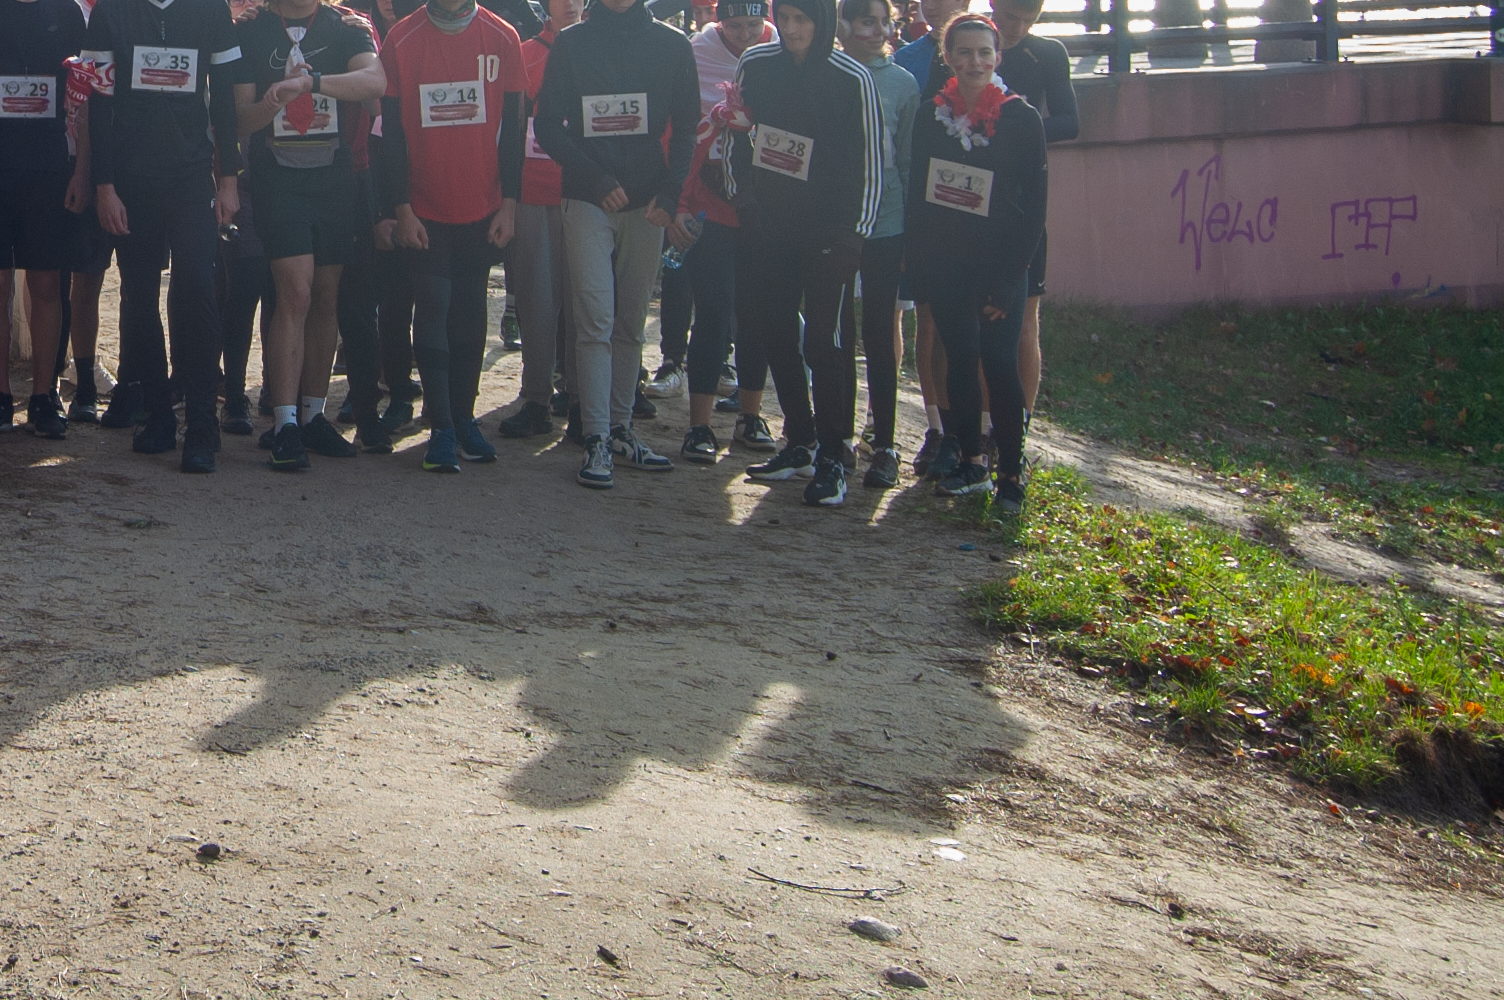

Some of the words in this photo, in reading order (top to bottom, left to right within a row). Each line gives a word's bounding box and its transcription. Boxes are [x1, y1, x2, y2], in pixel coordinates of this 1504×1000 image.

[725, 2, 762, 17] OREVER
[169, 56, 190, 70] 35
[477, 55, 500, 83] 10
[29, 83, 48, 97] 29
[457, 88, 477, 103] 14
[313, 98, 329, 112] 24
[620, 100, 639, 115] 15
[786, 140, 806, 157] 28
[964, 175, 972, 191] 1
